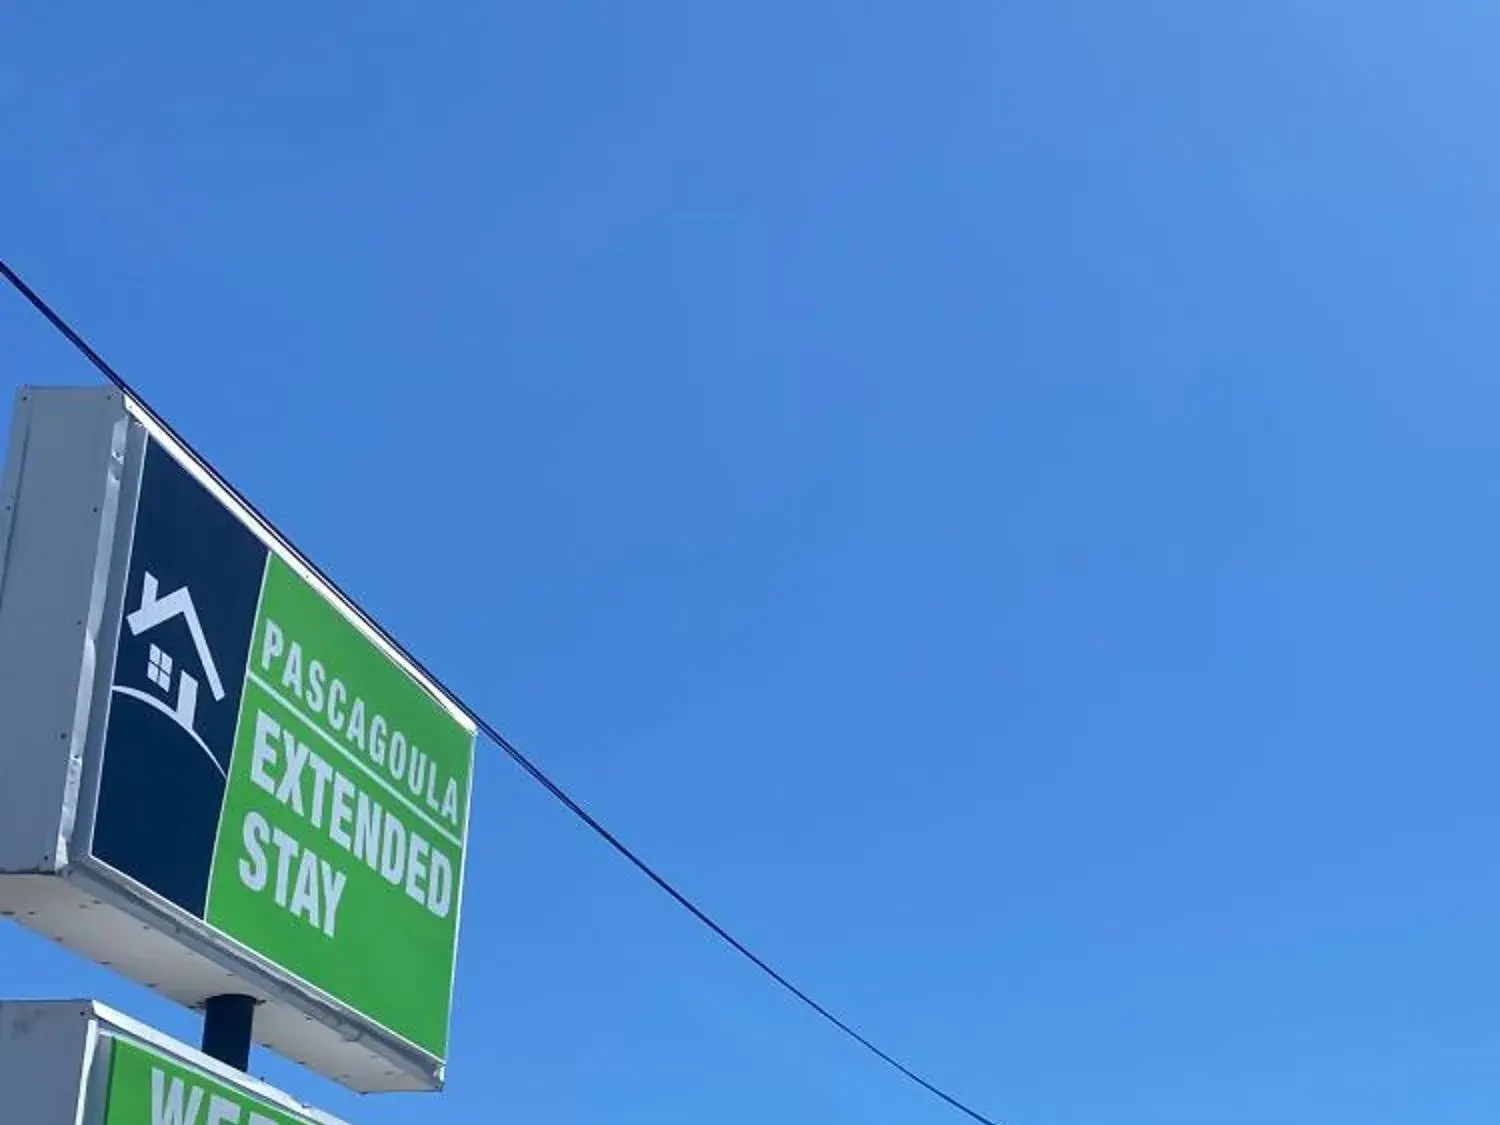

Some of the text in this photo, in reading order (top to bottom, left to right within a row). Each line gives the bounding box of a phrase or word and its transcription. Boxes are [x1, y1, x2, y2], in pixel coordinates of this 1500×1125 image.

[249, 707, 454, 919] EXTENDED
[261, 618, 458, 826] PASCAGOULA
[238, 810, 348, 939] STAY
